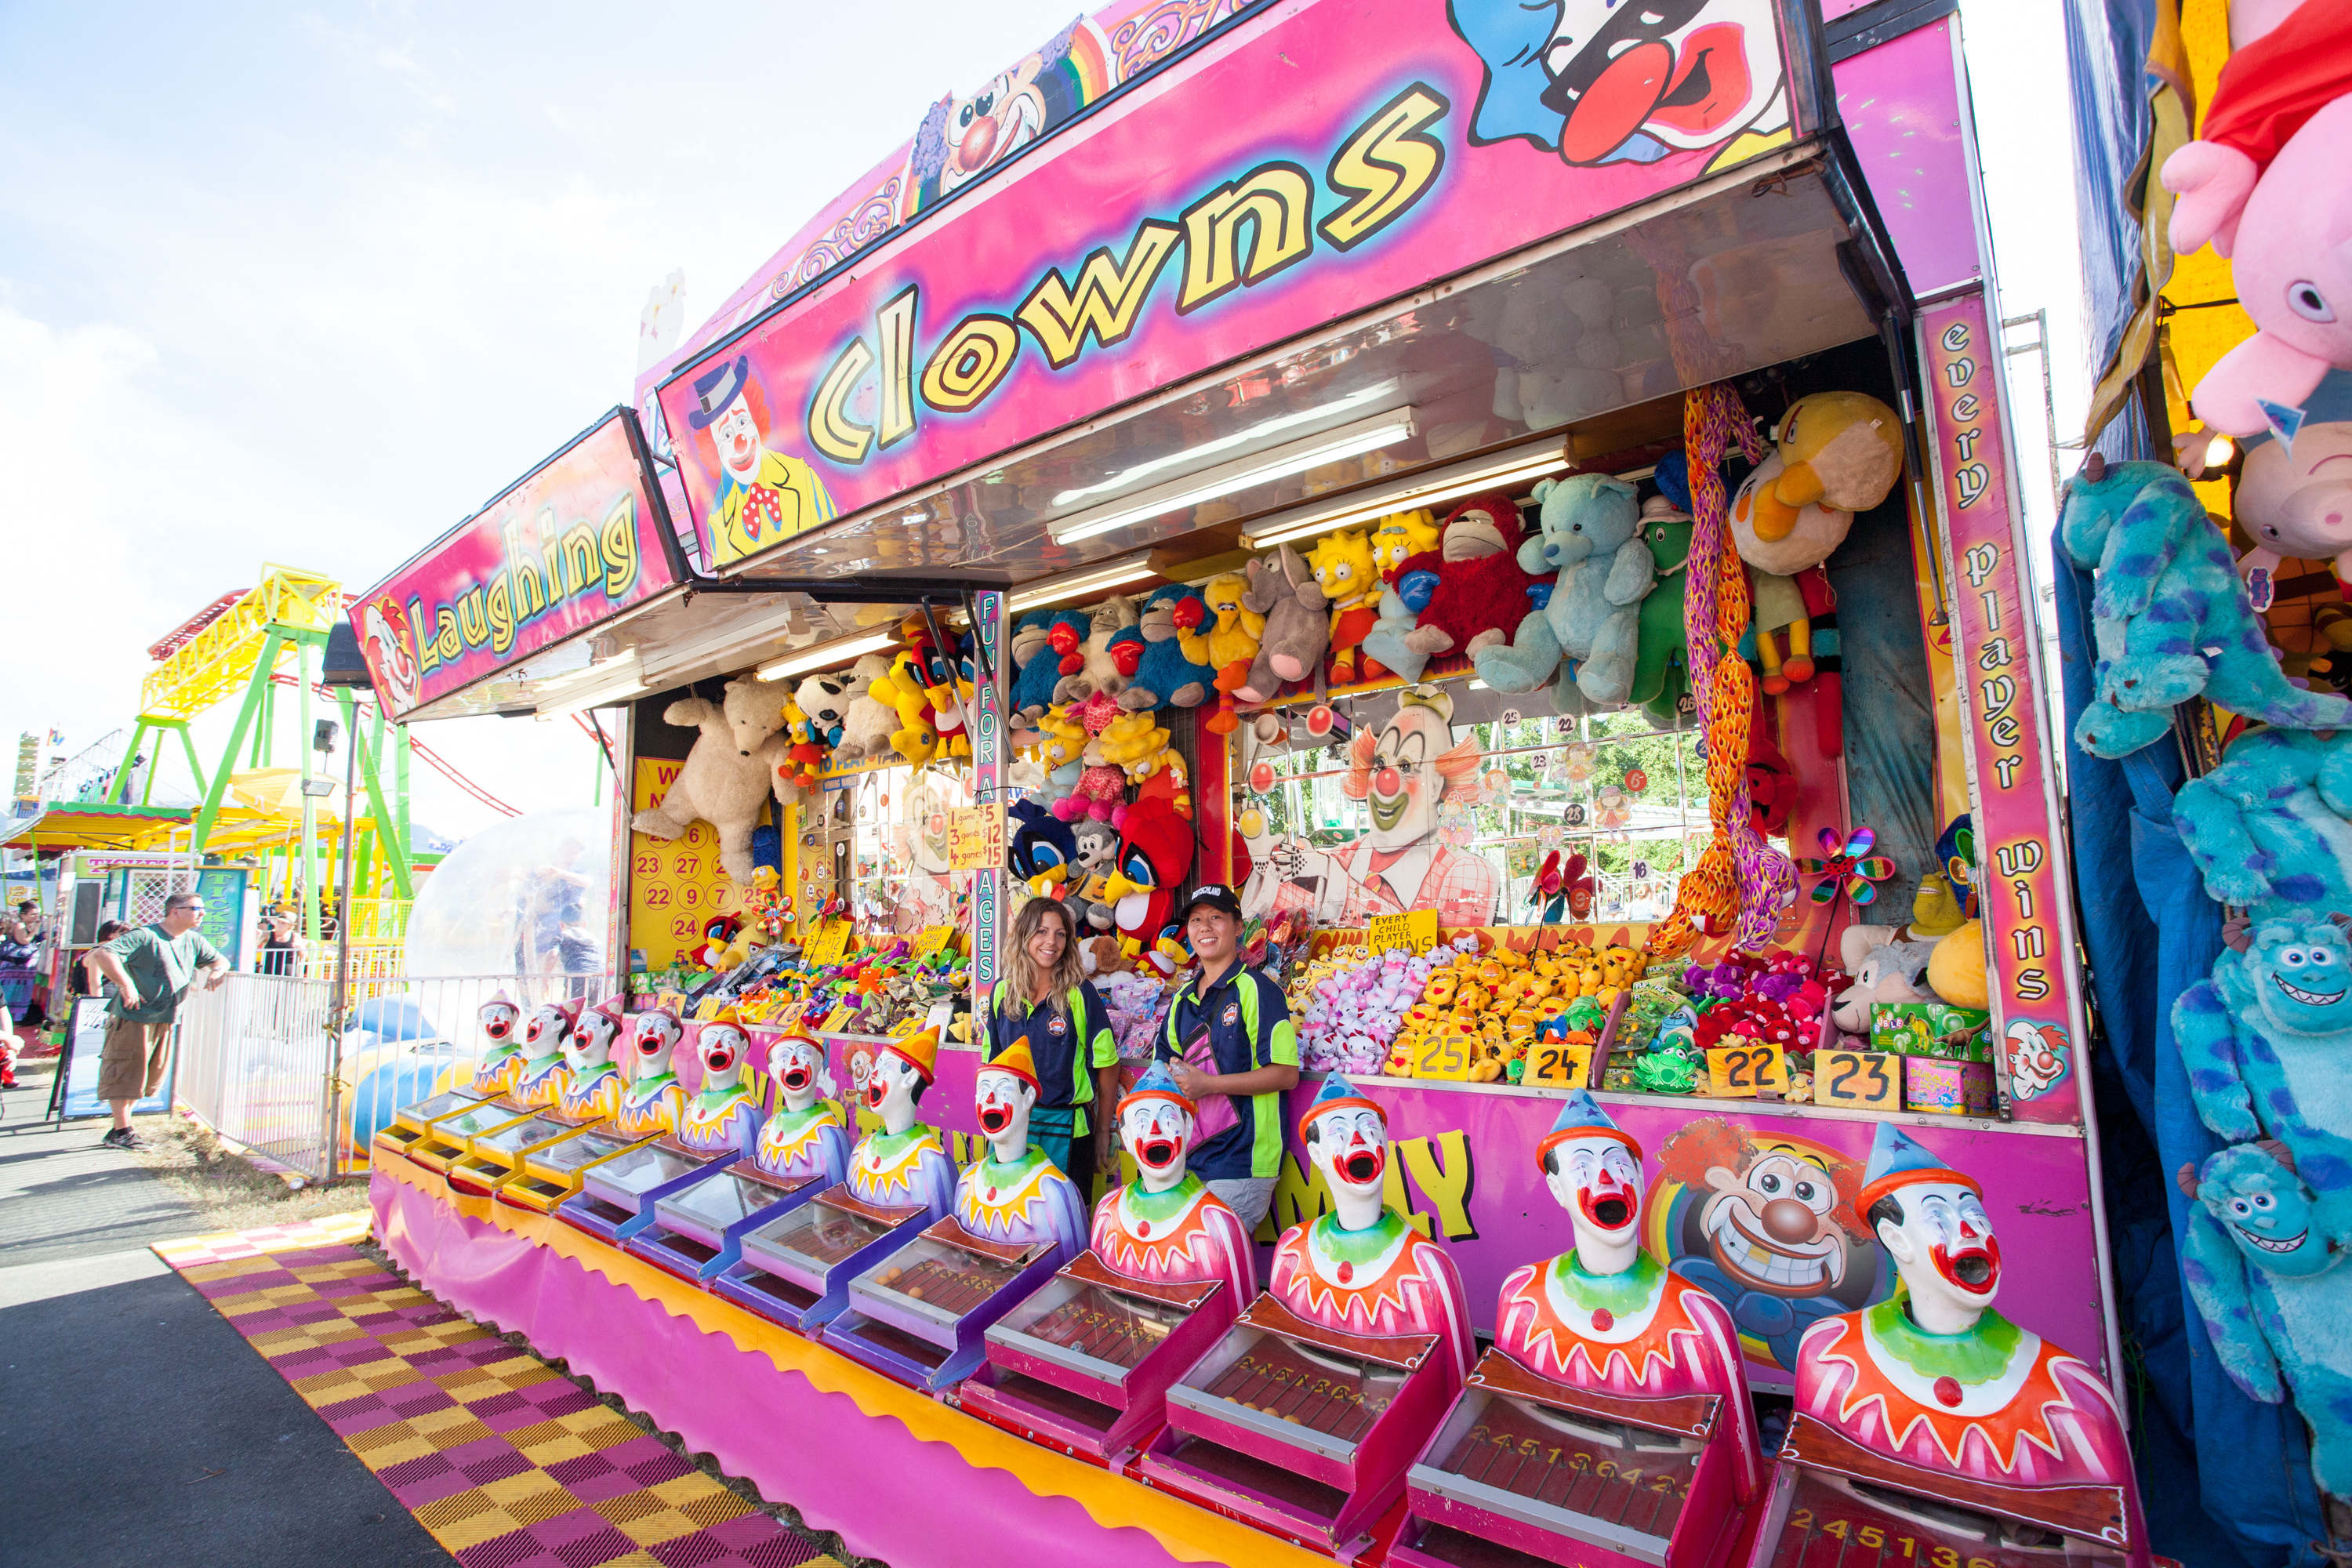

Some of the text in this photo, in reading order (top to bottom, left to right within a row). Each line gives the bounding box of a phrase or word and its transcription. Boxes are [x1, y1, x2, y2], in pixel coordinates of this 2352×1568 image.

[408, 81, 1450, 676] Laughing Clowns
[980, 596, 996, 673] FUN
[1942, 322, 2049, 1001] every player wins
[1679, 697, 1696, 713] 26
[979, 685, 996, 765] FOR
[1559, 720, 1574, 732] 22
[1534, 755, 1547, 769] 23
[824, 779, 840, 790] WINNING
[1631, 772, 1640, 789] 6
[951, 804, 994, 826] 1 game $5
[1566, 807, 1581, 822] 28
[689, 828, 699, 844] 6
[950, 823, 1001, 845] 3 games $12
[950, 845, 1001, 866] 4 games $15
[637, 857, 659, 873] 23
[677, 858, 699, 873] 27
[648, 888, 670, 905] 22
[687, 888, 697, 905] 9
[715, 889, 726, 905] 7
[1192, 886, 1221, 900] DEUTSCHLAND
[674, 920, 696, 935] 24
[978, 870, 994, 981] AGES
[1375, 913, 1409, 926] EVERY
[1378, 923, 1410, 934] CHILD
[808, 935, 814, 946] 3
[1374, 931, 1412, 944] PLAYER
[675, 949, 685, 964] 5
[1654, 985, 1668, 993] FLIP
[698, 999, 715, 1020] 12
[766, 1004, 782, 1016] 9
[788, 1005, 802, 1021] 8
[826, 1011, 848, 1030] 7
[895, 1020, 912, 1037] 6
[1874, 1011, 1903, 1034] BUBBLE
[1421, 1036, 1464, 1073] 25
[1537, 1049, 1578, 1080] 24
[1725, 1047, 1775, 1087] 22
[1830, 1054, 1889, 1102] 23
[1910, 1067, 1955, 1088] BUBBLE
